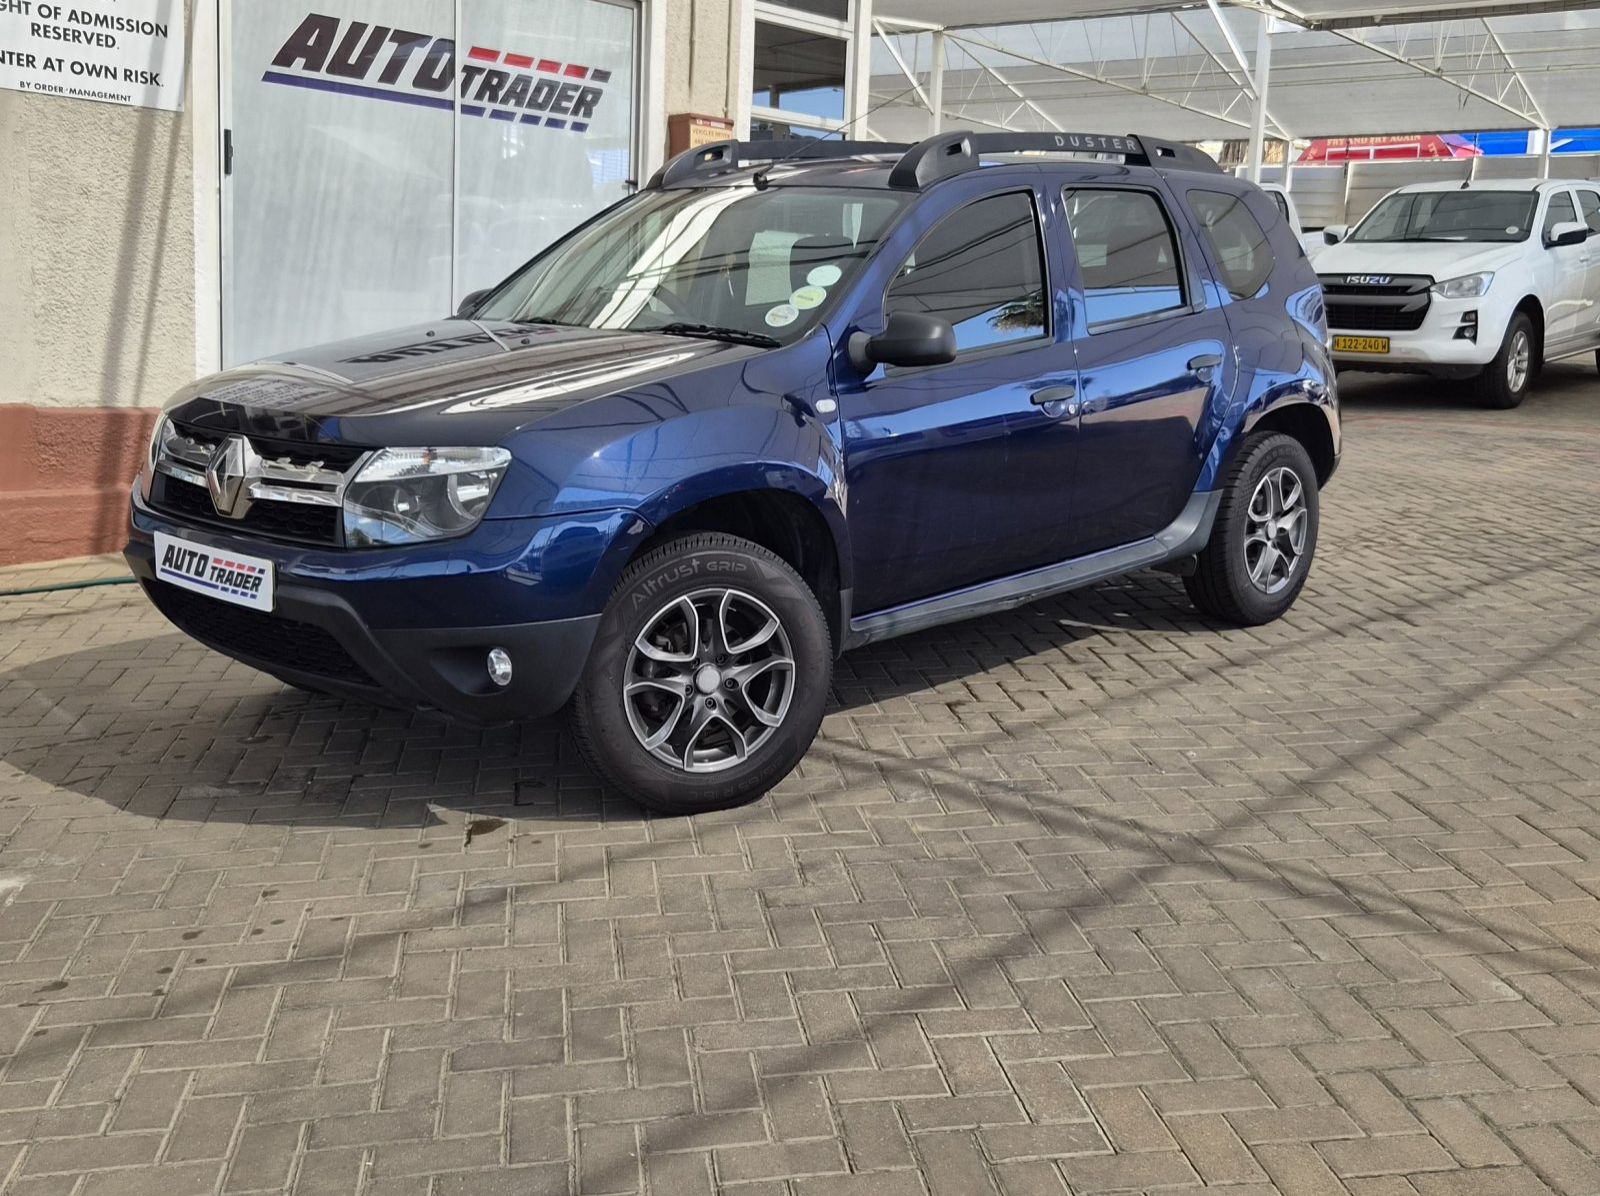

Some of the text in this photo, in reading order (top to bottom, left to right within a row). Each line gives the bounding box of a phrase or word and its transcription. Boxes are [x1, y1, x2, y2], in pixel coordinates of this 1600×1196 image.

[37, 4, 61, 20] OF
[67, 9, 168, 38] ADMISSION
[30, 22, 120, 50] RESERVED.
[42, 56, 65, 73] AT
[70, 61, 118, 81] OWN
[123, 68, 164, 87] RISK.
[271, 12, 604, 119] AUTO TRADER
[34, 83, 64, 94] ORDER
[1054, 135, 1136, 151] DUSTER
[1346, 275, 1390, 284] ISUZU
[1343, 339, 1379, 350] 122-240
[162, 544, 264, 593] AUTO TRADER
[706, 561, 747, 572] GRIP
